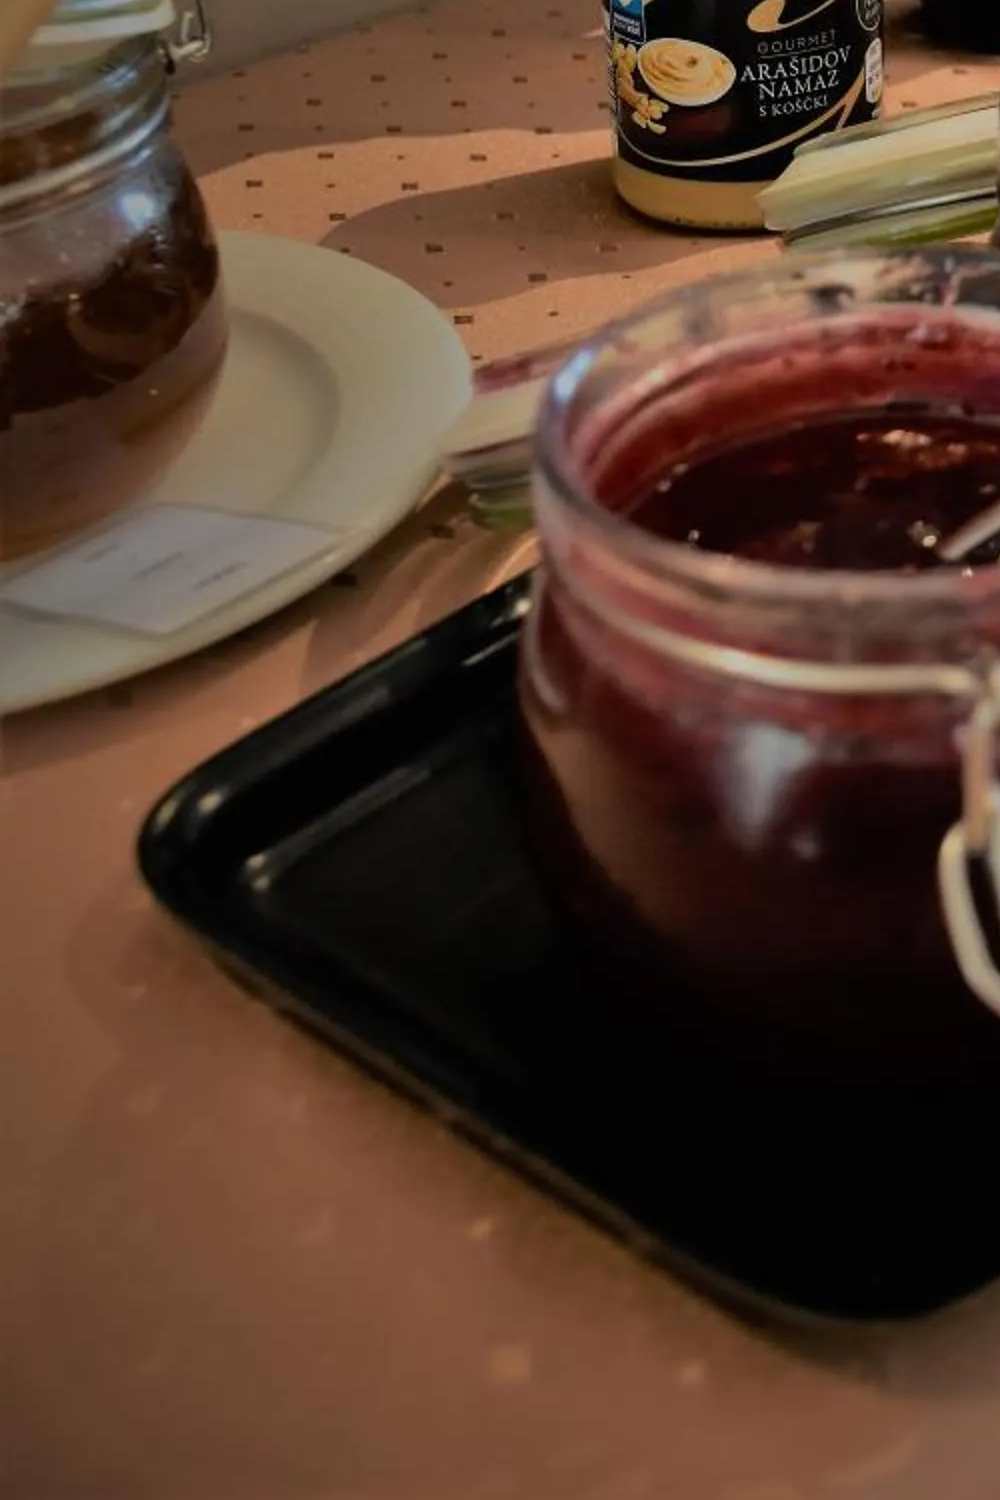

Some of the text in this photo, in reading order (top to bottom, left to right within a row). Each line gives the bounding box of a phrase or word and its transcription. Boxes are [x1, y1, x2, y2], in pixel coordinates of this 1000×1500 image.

[757, 28, 836, 54] GOURMET
[740, 44, 852, 83] ARAŠIDOV
[758, 68, 840, 101] NAMAZ
